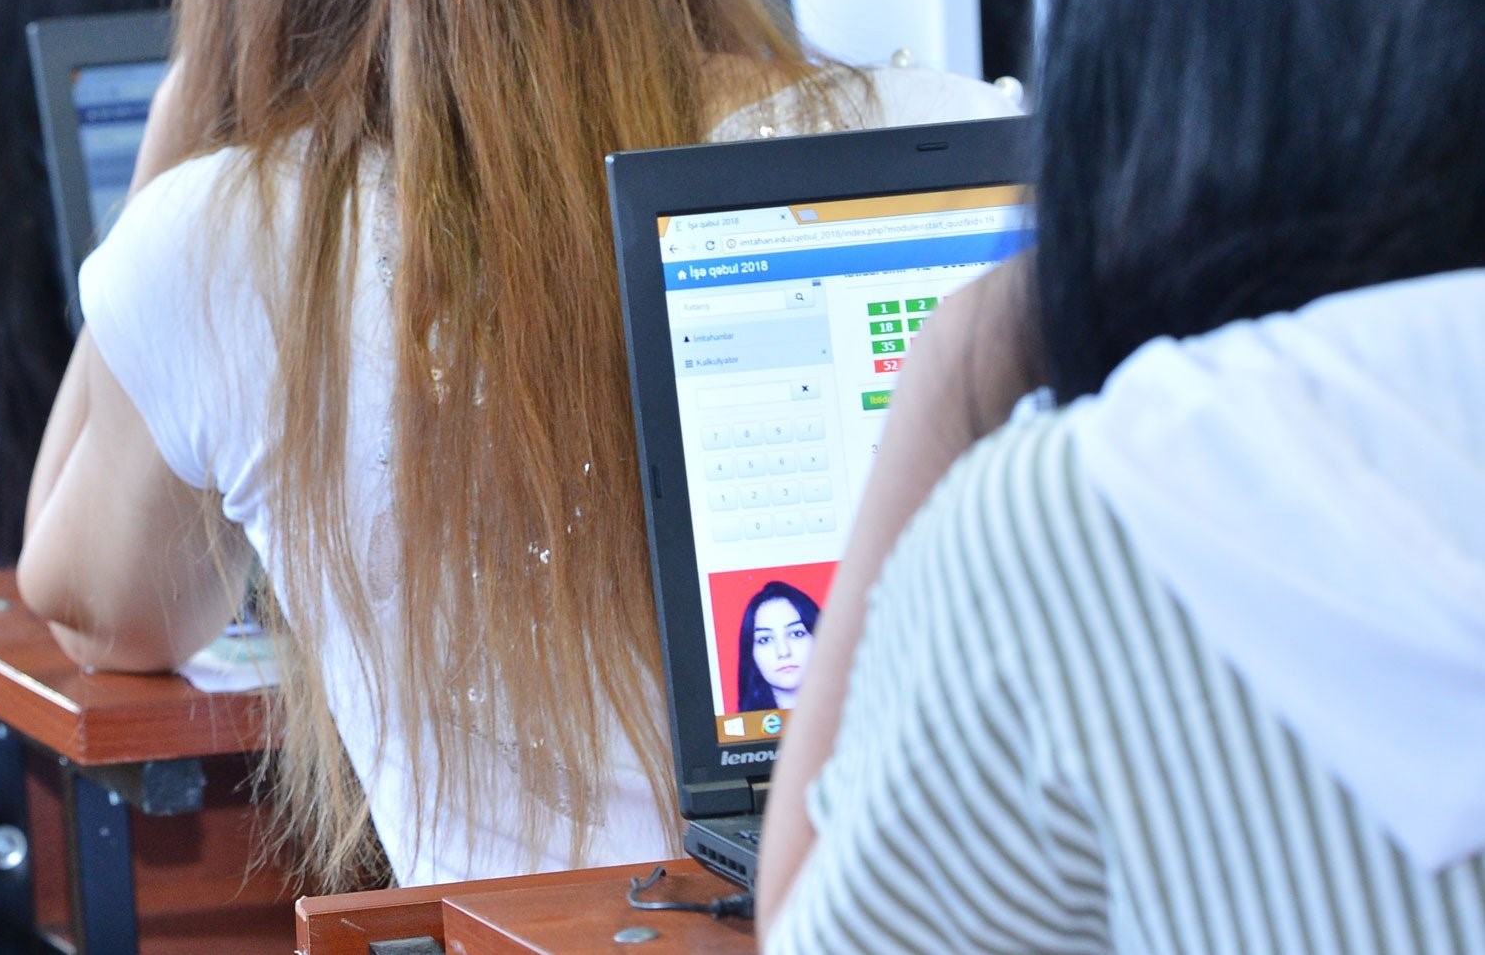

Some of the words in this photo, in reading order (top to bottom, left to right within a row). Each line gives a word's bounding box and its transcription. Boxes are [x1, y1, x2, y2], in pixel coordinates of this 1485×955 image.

[722, 217, 739, 226] 2018
[689, 264, 707, 280] İşə
[709, 263, 739, 278] qəbul
[741, 260, 769, 274] 2018
[880, 304, 889, 314] 1
[918, 300, 926, 310] 2
[879, 322, 894, 333] 18
[881, 341, 896, 352] 35
[883, 360, 899, 371] 52
[720, 750, 779, 766] lenov
